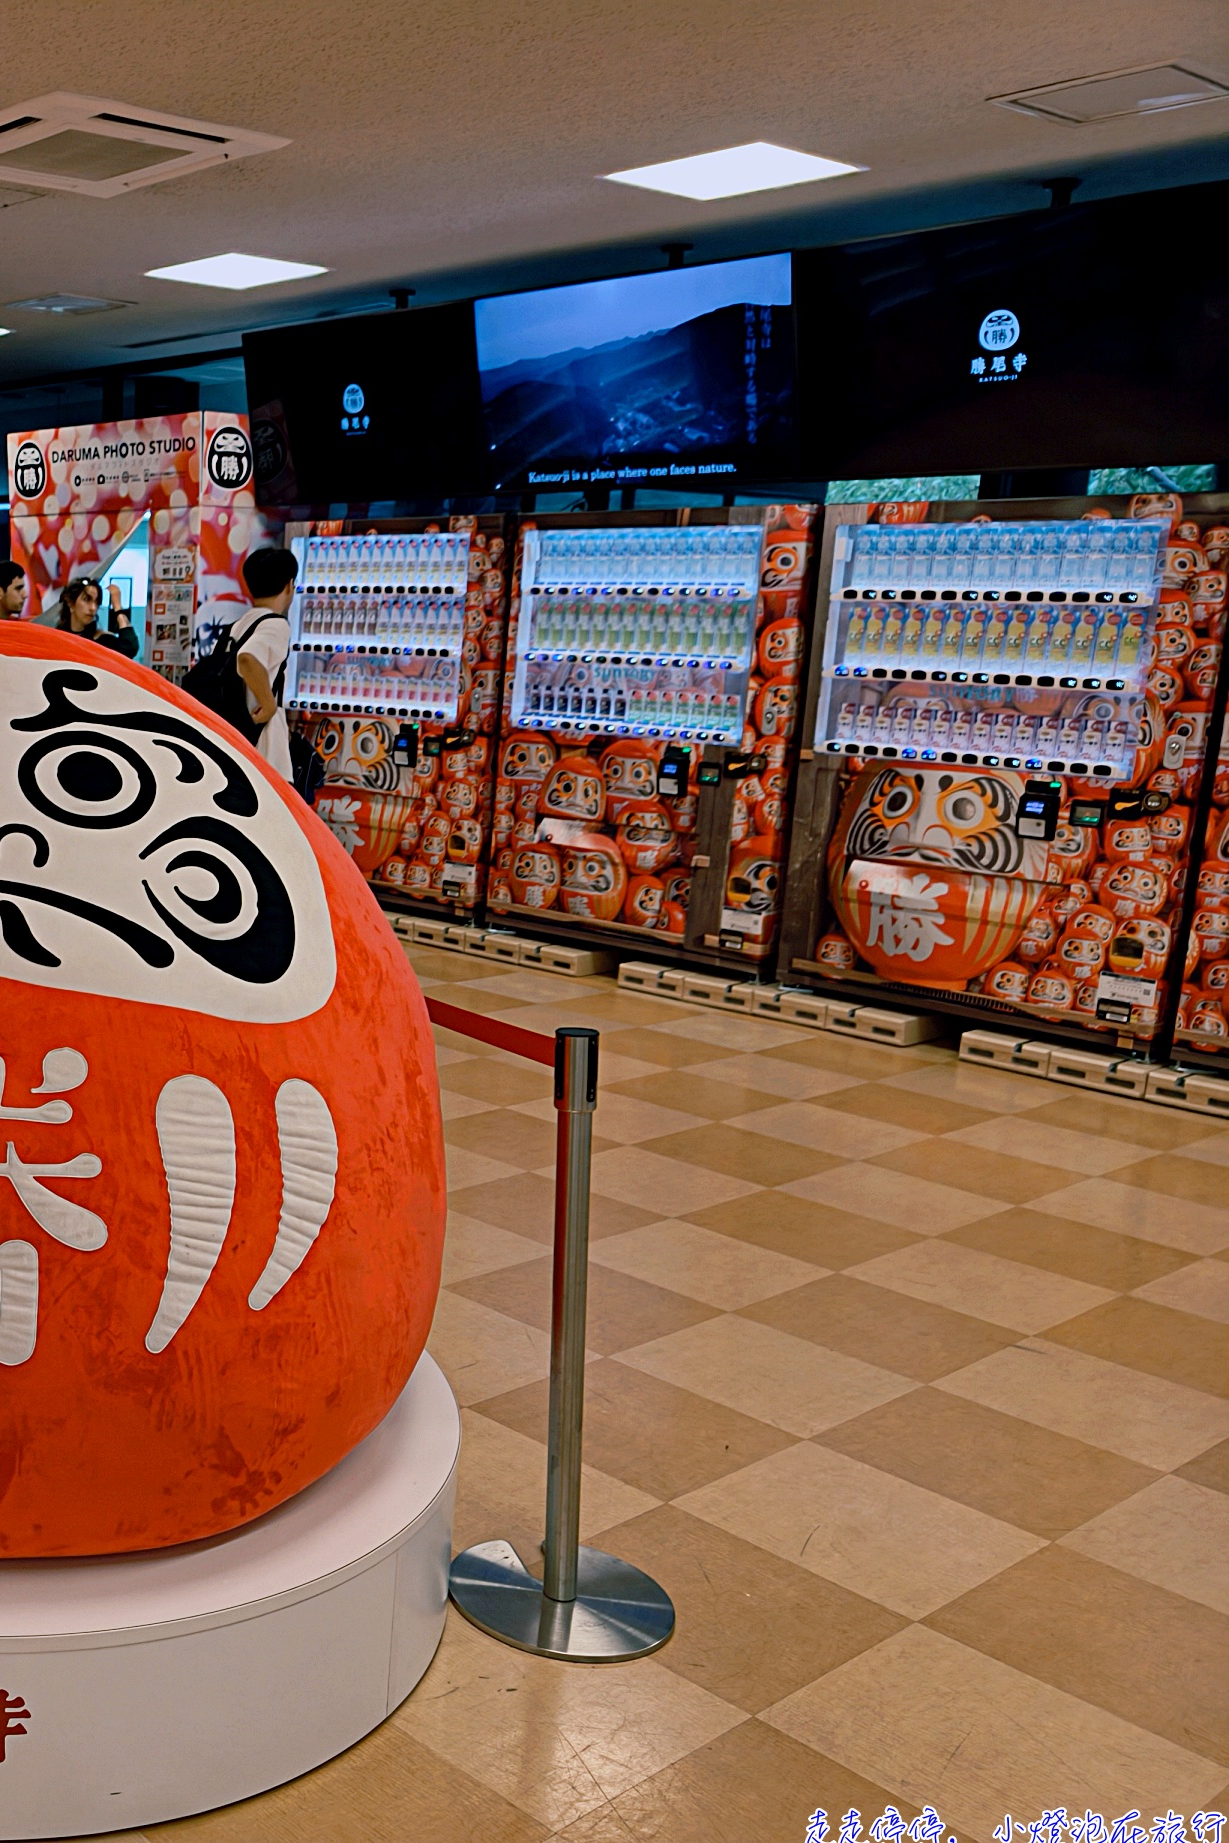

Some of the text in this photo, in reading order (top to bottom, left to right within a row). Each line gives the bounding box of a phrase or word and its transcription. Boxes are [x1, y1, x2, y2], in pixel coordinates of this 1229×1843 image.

[970, 352, 1028, 375] 勝尾寺
[51, 437, 196, 464] DARUMA PHOTO STUDIO
[221, 455, 239, 480] 勝
[572, 469, 580, 481] is
[582, 472, 589, 480] a
[590, 467, 615, 482] place
[617, 465, 648, 478] where
[649, 468, 668, 477] one
[669, 463, 696, 476] faces
[698, 463, 737, 475] nature.
[929, 684, 1017, 702] SUNTORY
[866, 873, 956, 962] 勝
